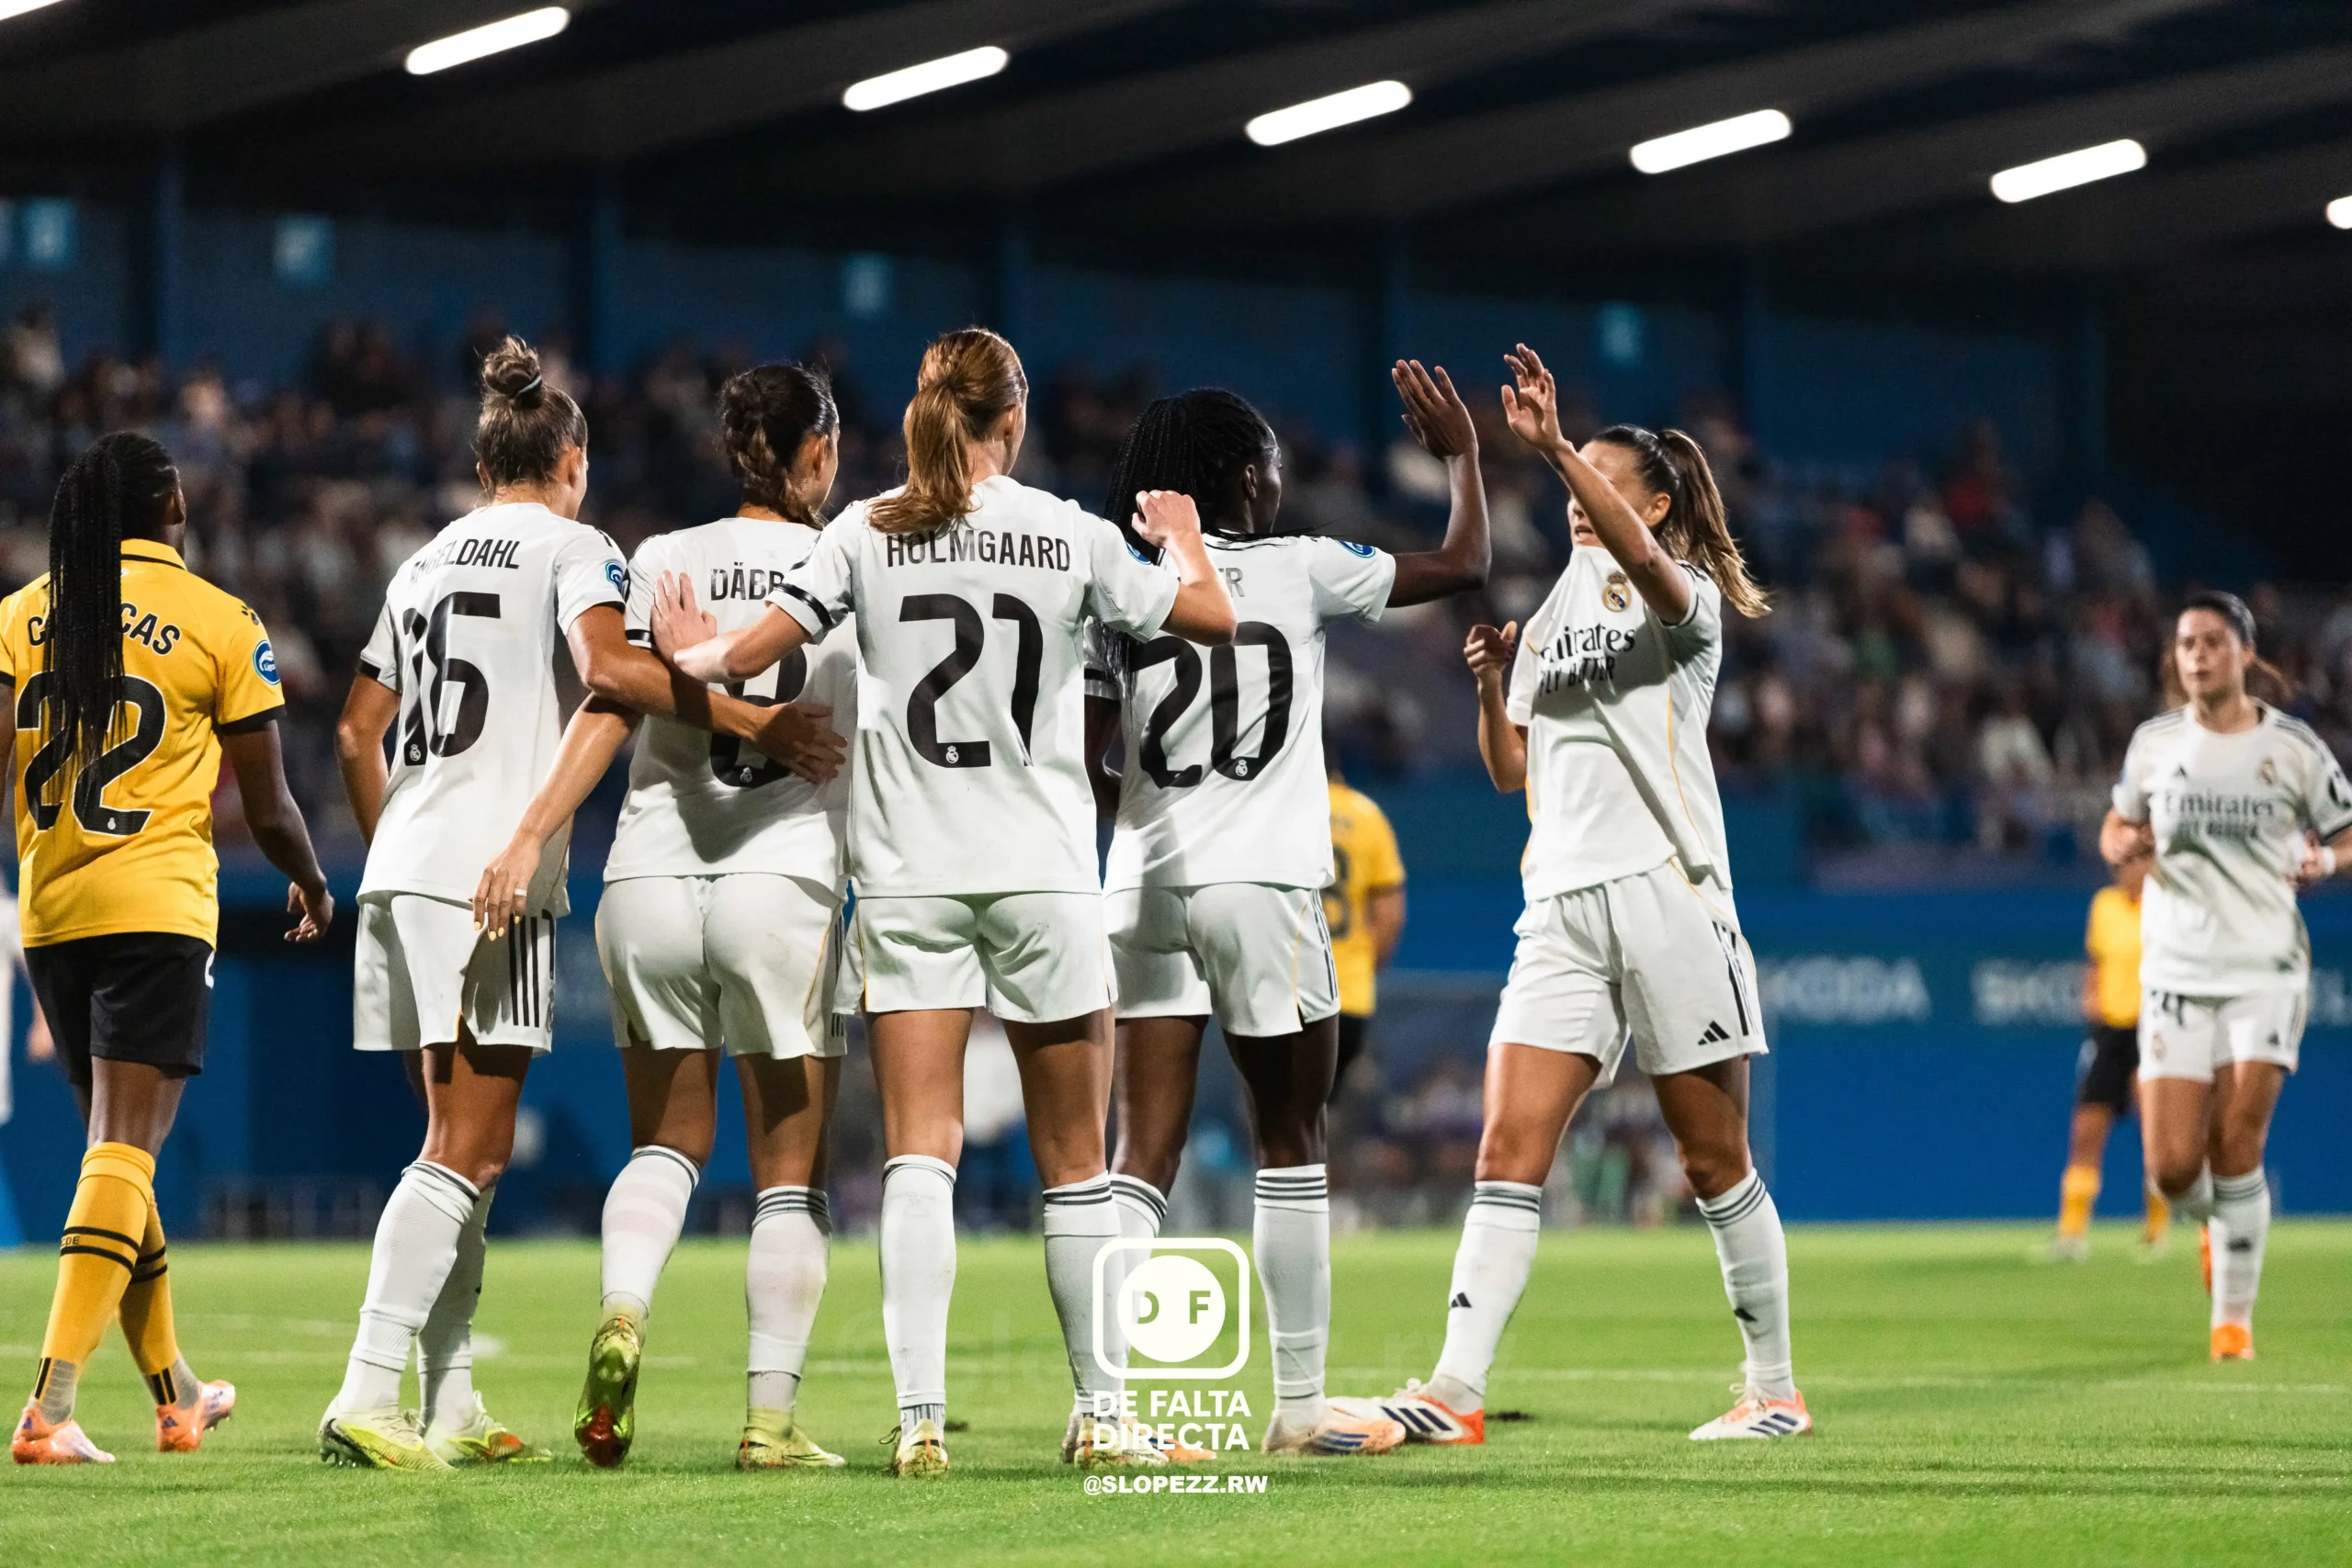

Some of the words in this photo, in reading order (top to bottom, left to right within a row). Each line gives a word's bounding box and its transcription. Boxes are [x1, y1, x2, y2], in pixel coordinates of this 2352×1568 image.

[887, 530, 1070, 571] HOLMGAARD
[17, 671, 166, 838] 22
[402, 591, 501, 766] 16
[899, 593, 1044, 768] 21
[1129, 621, 1294, 789] 20
